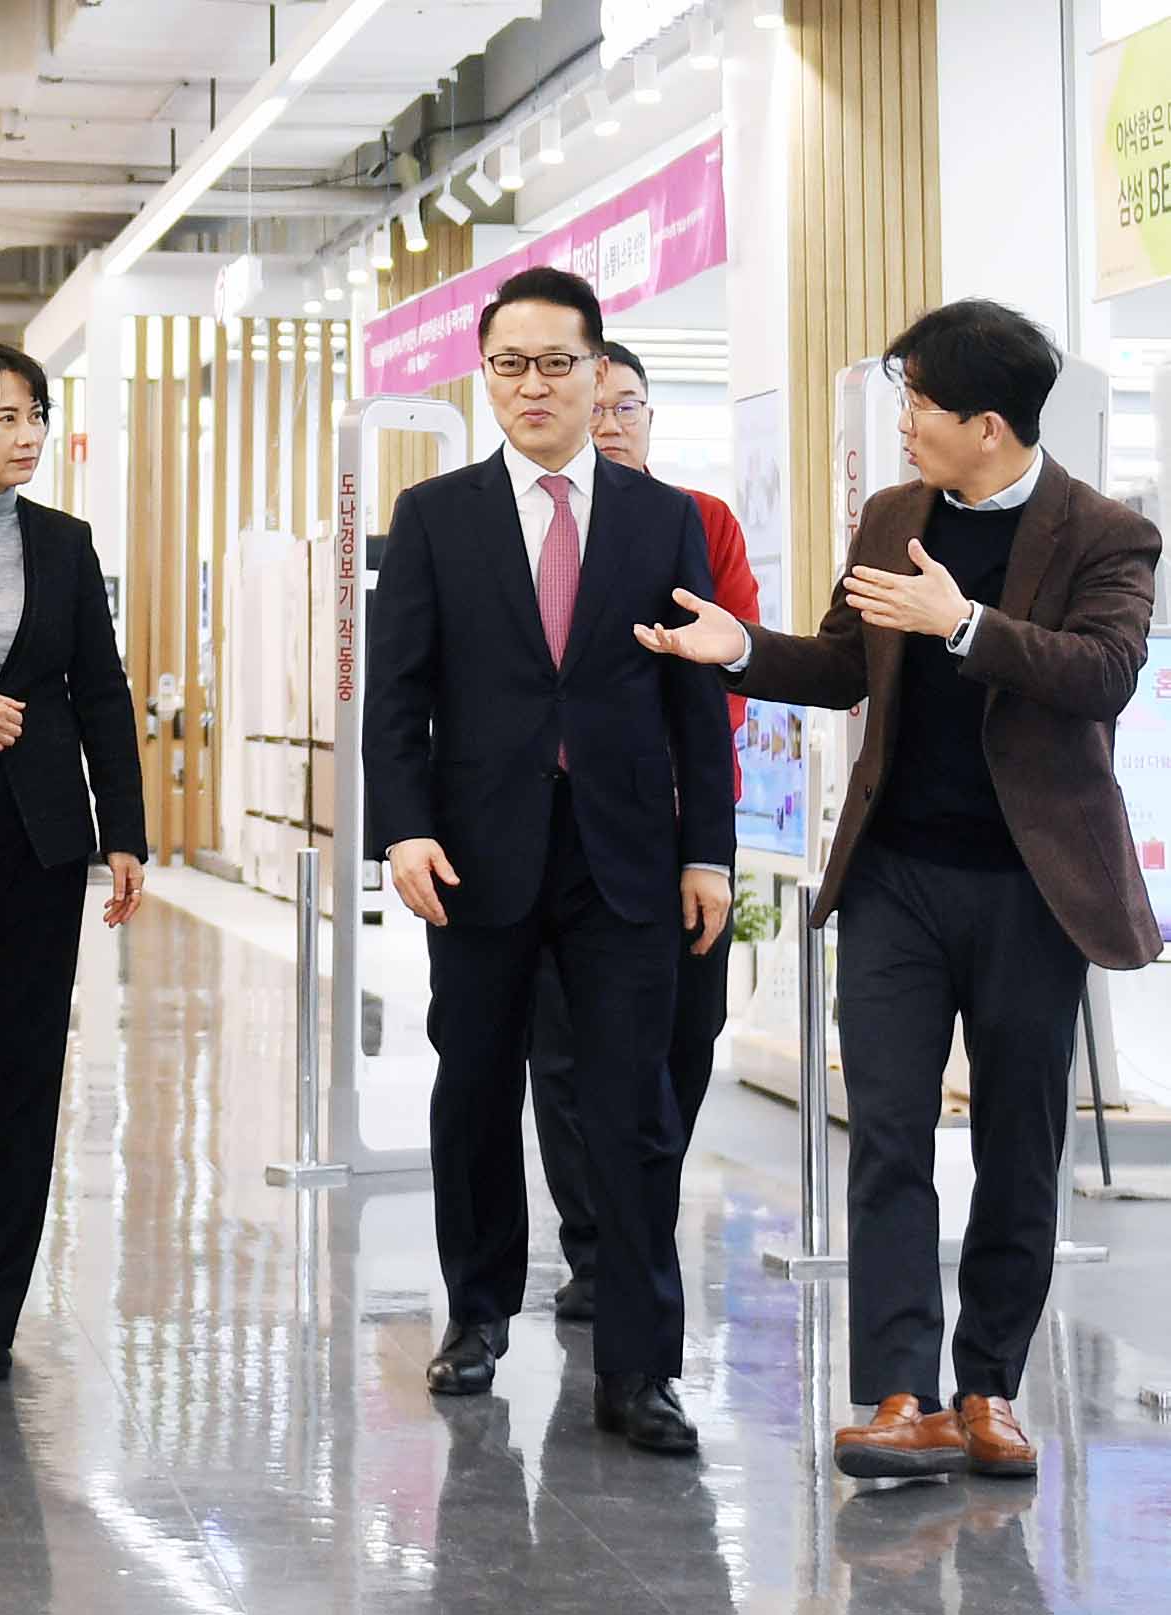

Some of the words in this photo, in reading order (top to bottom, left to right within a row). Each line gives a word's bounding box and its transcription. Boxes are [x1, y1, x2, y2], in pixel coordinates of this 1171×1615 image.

[1118, 168, 1144, 227] 삼성
[846, 449, 858, 543] CCT
[340, 474, 356, 611] 도난경보기
[337, 619, 354, 701] 작동중
